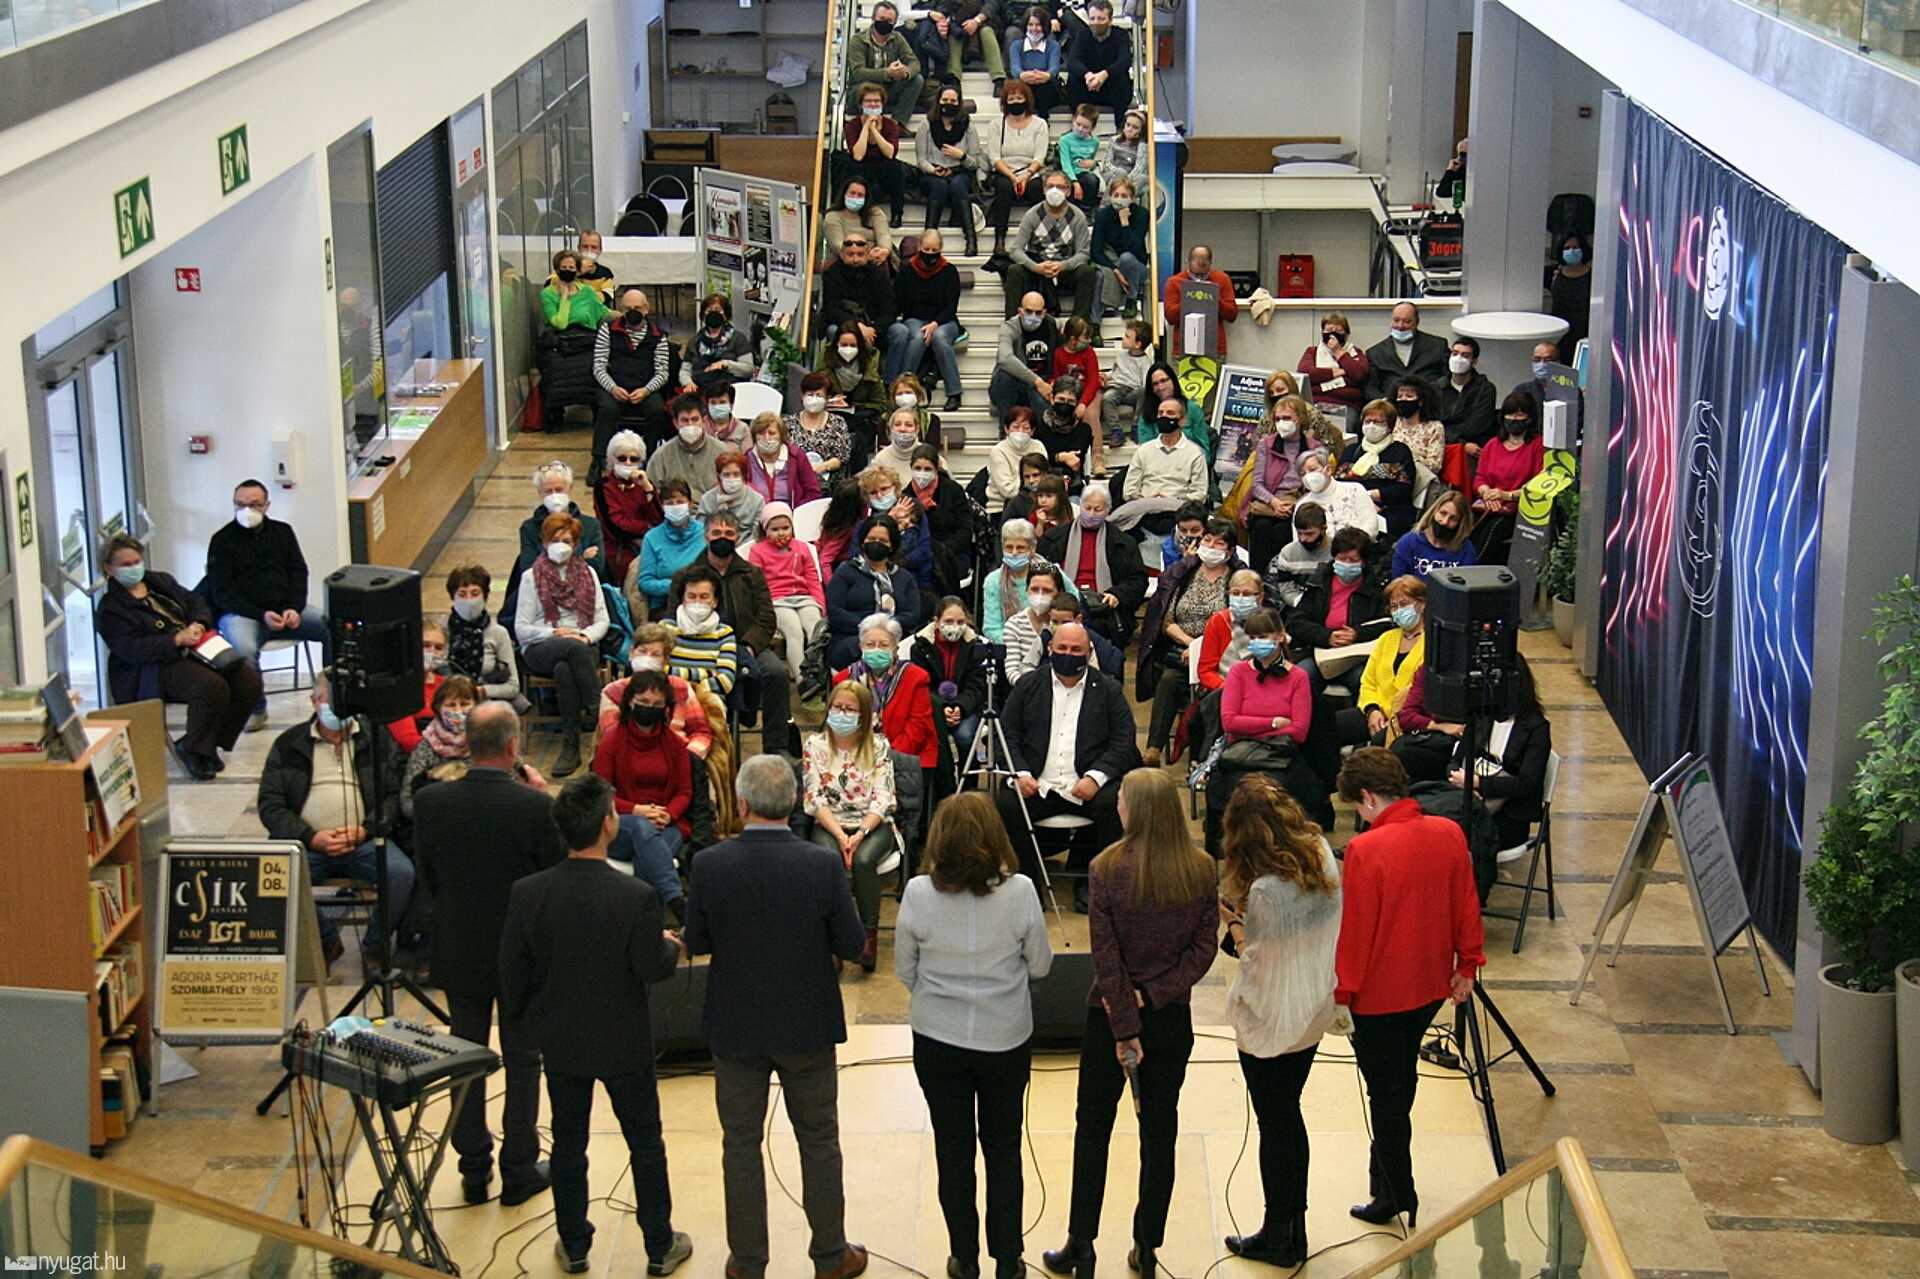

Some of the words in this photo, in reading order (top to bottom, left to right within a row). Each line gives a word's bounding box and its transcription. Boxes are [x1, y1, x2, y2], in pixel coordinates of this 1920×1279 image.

[1231, 404, 1241, 415] 55
[263, 862, 286, 875] 04.
[263, 878, 286, 891] 08.
[175, 870, 248, 923] CSÍK
[208, 920, 246, 943] LGT
[215, 969, 279, 983] SPORTHÁZ
[171, 985, 247, 995] SZOMBATHELY
[251, 986, 278, 995] 19:00
